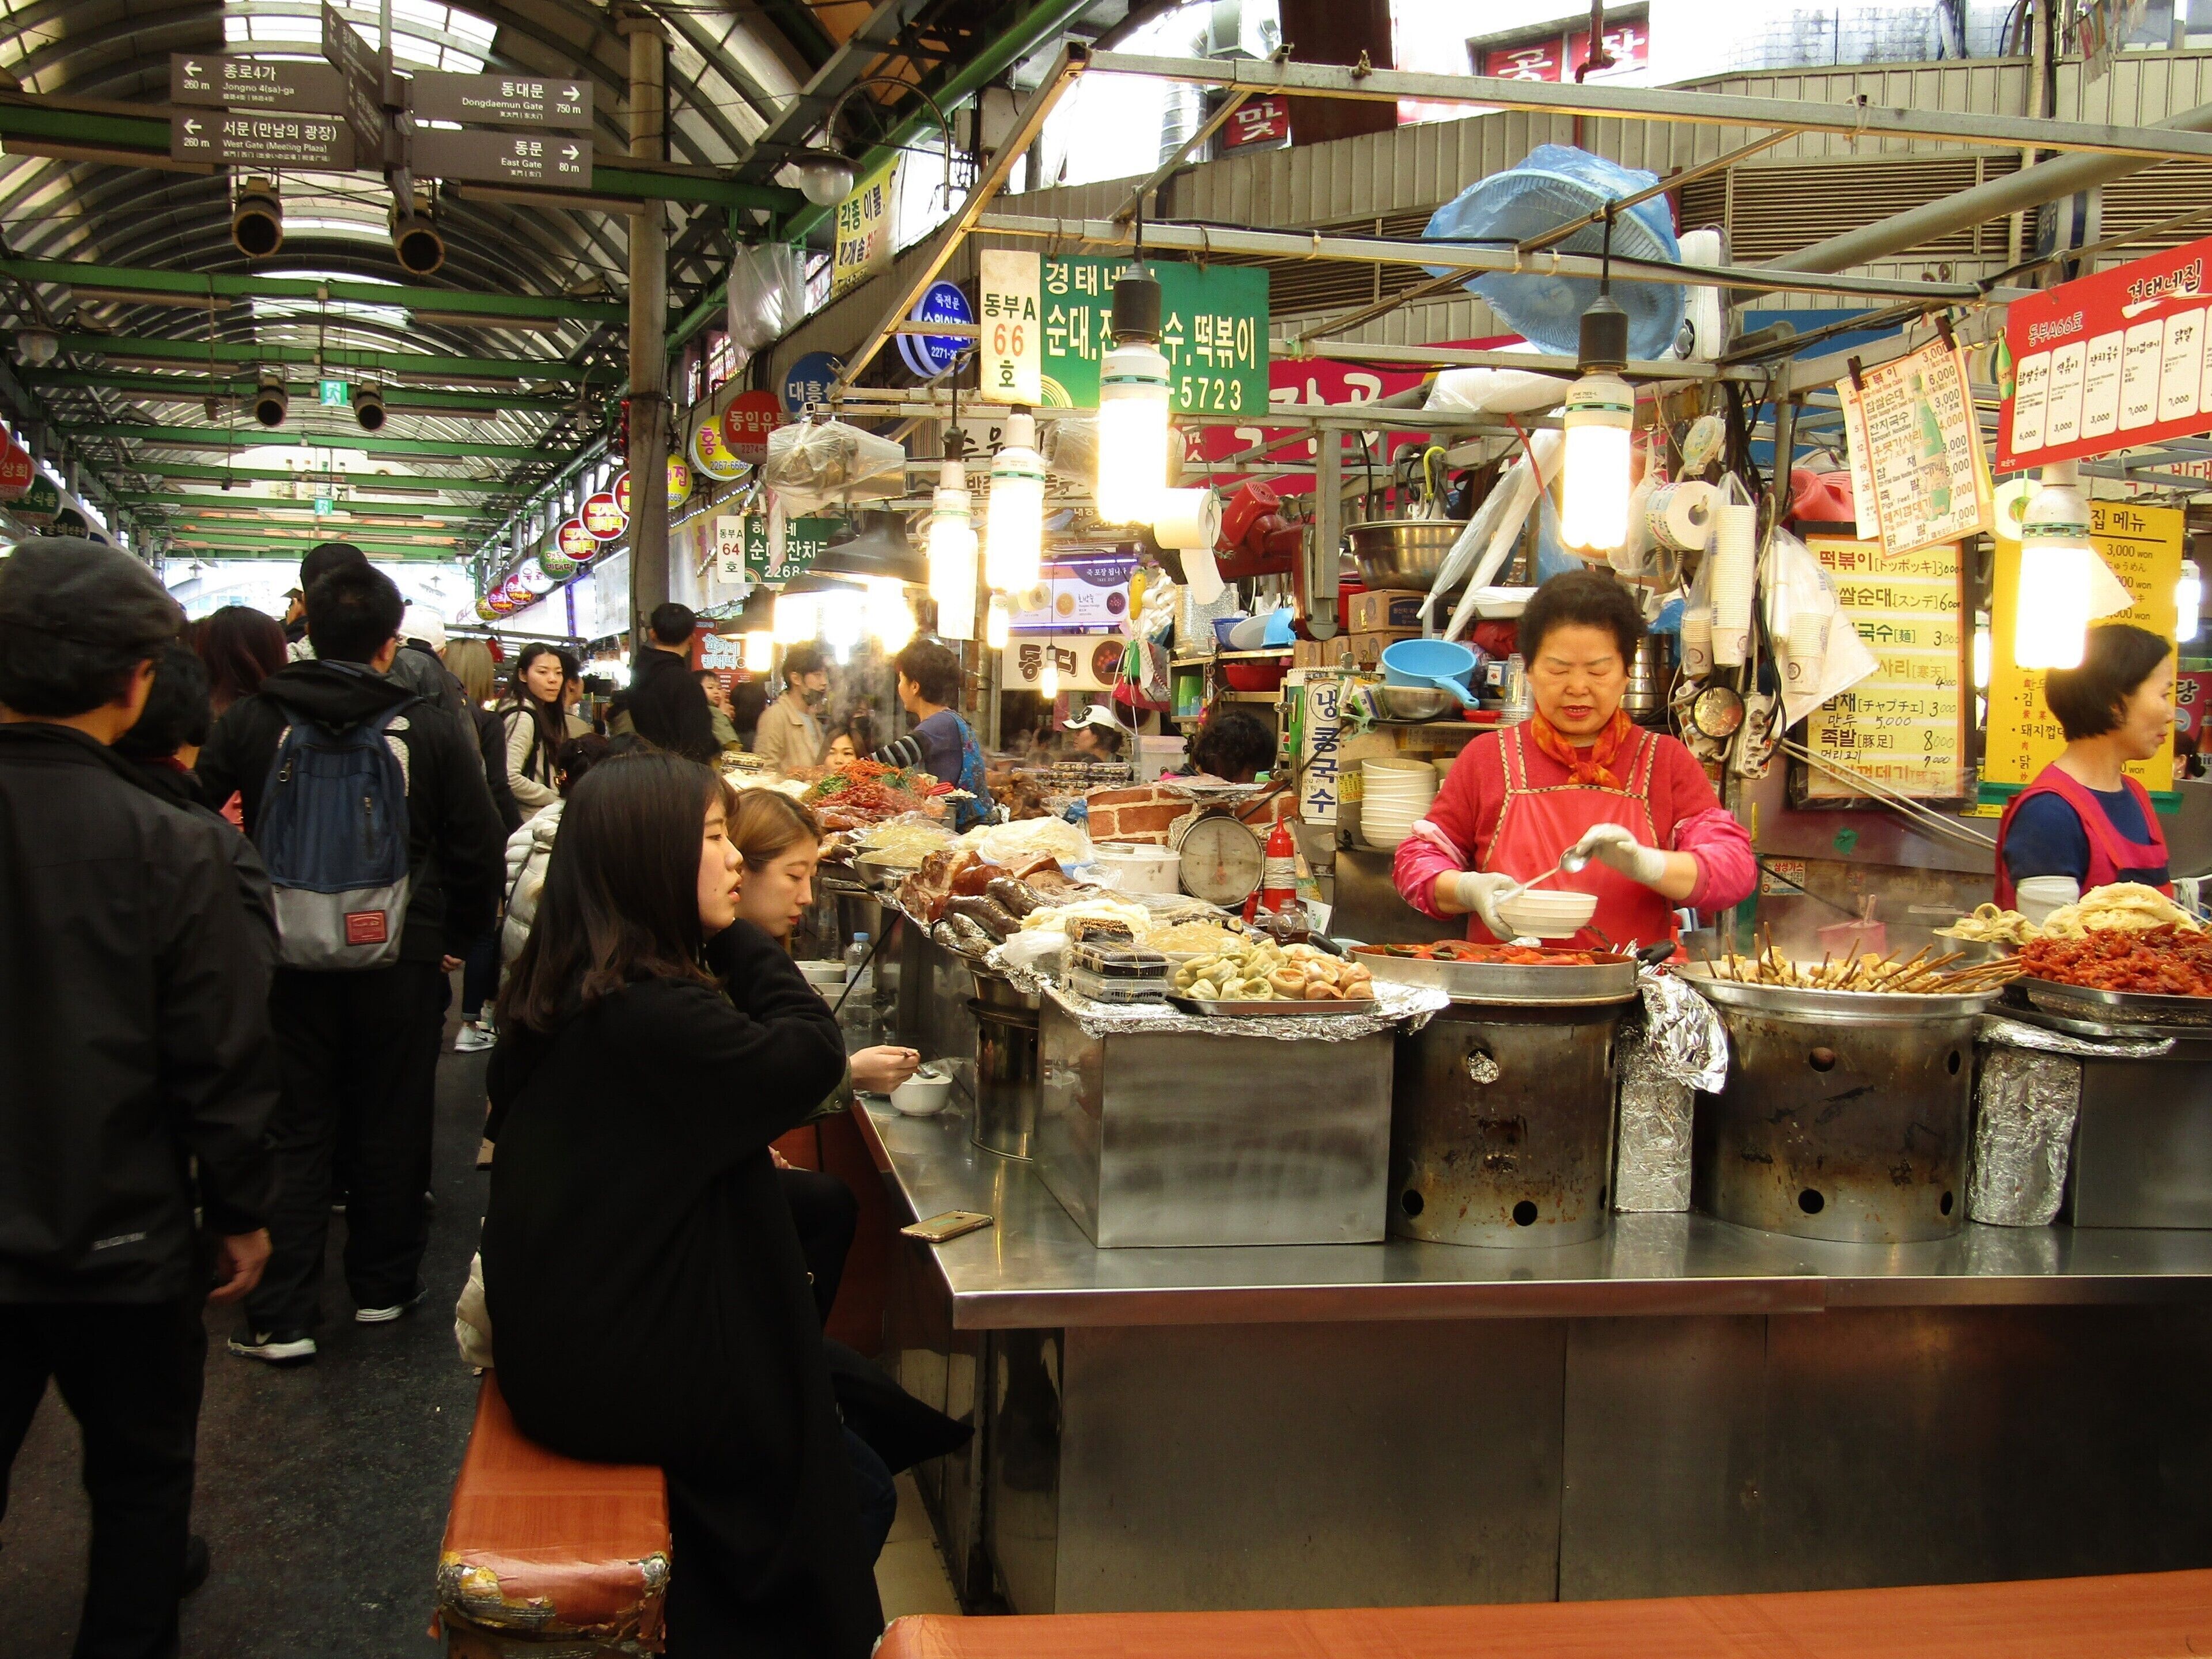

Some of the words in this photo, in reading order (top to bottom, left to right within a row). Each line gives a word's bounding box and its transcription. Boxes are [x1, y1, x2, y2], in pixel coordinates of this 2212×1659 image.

[224, 63, 276, 81] 종로4가
[184, 80, 199, 89] 260
[201, 82, 210, 90] m
[223, 82, 257, 93] Jongno
[259, 85, 294, 95] 4(sa)-ga
[501, 82, 544, 99] 동대문
[463, 97, 520, 109] Dongdaemun
[523, 101, 544, 111] Gate
[556, 103, 570, 113] 750
[573, 106, 581, 114] m
[1235, 102, 1282, 141] 맛
[224, 122, 249, 137] 서문
[253, 122, 299, 139] (만남의
[305, 125, 337, 142] 광장)
[184, 138, 199, 147] 260
[201, 140, 210, 148] m
[223, 139, 244, 149] West
[246, 141, 264, 150] Gate
[267, 142, 301, 153] (Meeting
[304, 143, 327, 153] Plaza)
[515, 141, 543, 157] 동문
[501, 158, 519, 167] East
[522, 160, 542, 169] Gate
[559, 162, 569, 172] 80
[571, 165, 579, 173] m
[841, 198, 861, 232] 각종
[1046, 263, 1127, 297] 경태네
[2128, 258, 2202, 305] 경태네집
[935, 293, 960, 310] 죽전문
[984, 293, 1036, 321] 동부A
[2028, 311, 2083, 347] 동부A66호
[2175, 325, 2193, 344] 닭발
[994, 323, 1024, 357] 66
[2056, 355, 2078, 375] 떡볶이
[2089, 346, 2118, 367] 잔치국수
[999, 359, 1015, 388] 호
[1929, 365, 1956, 385] 6,000
[1934, 388, 1960, 408] 3,000
[2168, 395, 2189, 407] 7,000
[2090, 412, 2110, 424] 3,000
[2128, 404, 2148, 416] 7,000
[1939, 411, 1964, 431] 4,000
[2054, 421, 2072, 433] 3,000
[2018, 430, 2036, 440] 6,000
[1942, 434, 1967, 454] 3,000
[1945, 458, 1969, 477] 8,000
[1950, 505, 1976, 524] 7,000
[2113, 511, 2146, 533] 메뉴
[719, 528, 744, 539] 동부A
[722, 543, 741, 556] 64
[2106, 544, 2135, 558] 3,000
[2137, 551, 2153, 559] won
[725, 560, 738, 573] 호
[1820, 550, 1872, 571] 떡볶이
[2135, 581, 2152, 590] won
[1839, 586, 1892, 608] 쌀순대
[2134, 612, 2150, 621] won
[1851, 622, 1893, 643] 국수
[1875, 659, 1910, 679] 사리
[2022, 692, 2033, 707] 김
[1828, 713, 1858, 728] 만두
[1821, 728, 1857, 748] 족발
[1923, 730, 1955, 751] 8000
[2128, 766, 2145, 775] won
[1774, 863, 1804, 872] 삼성가스
